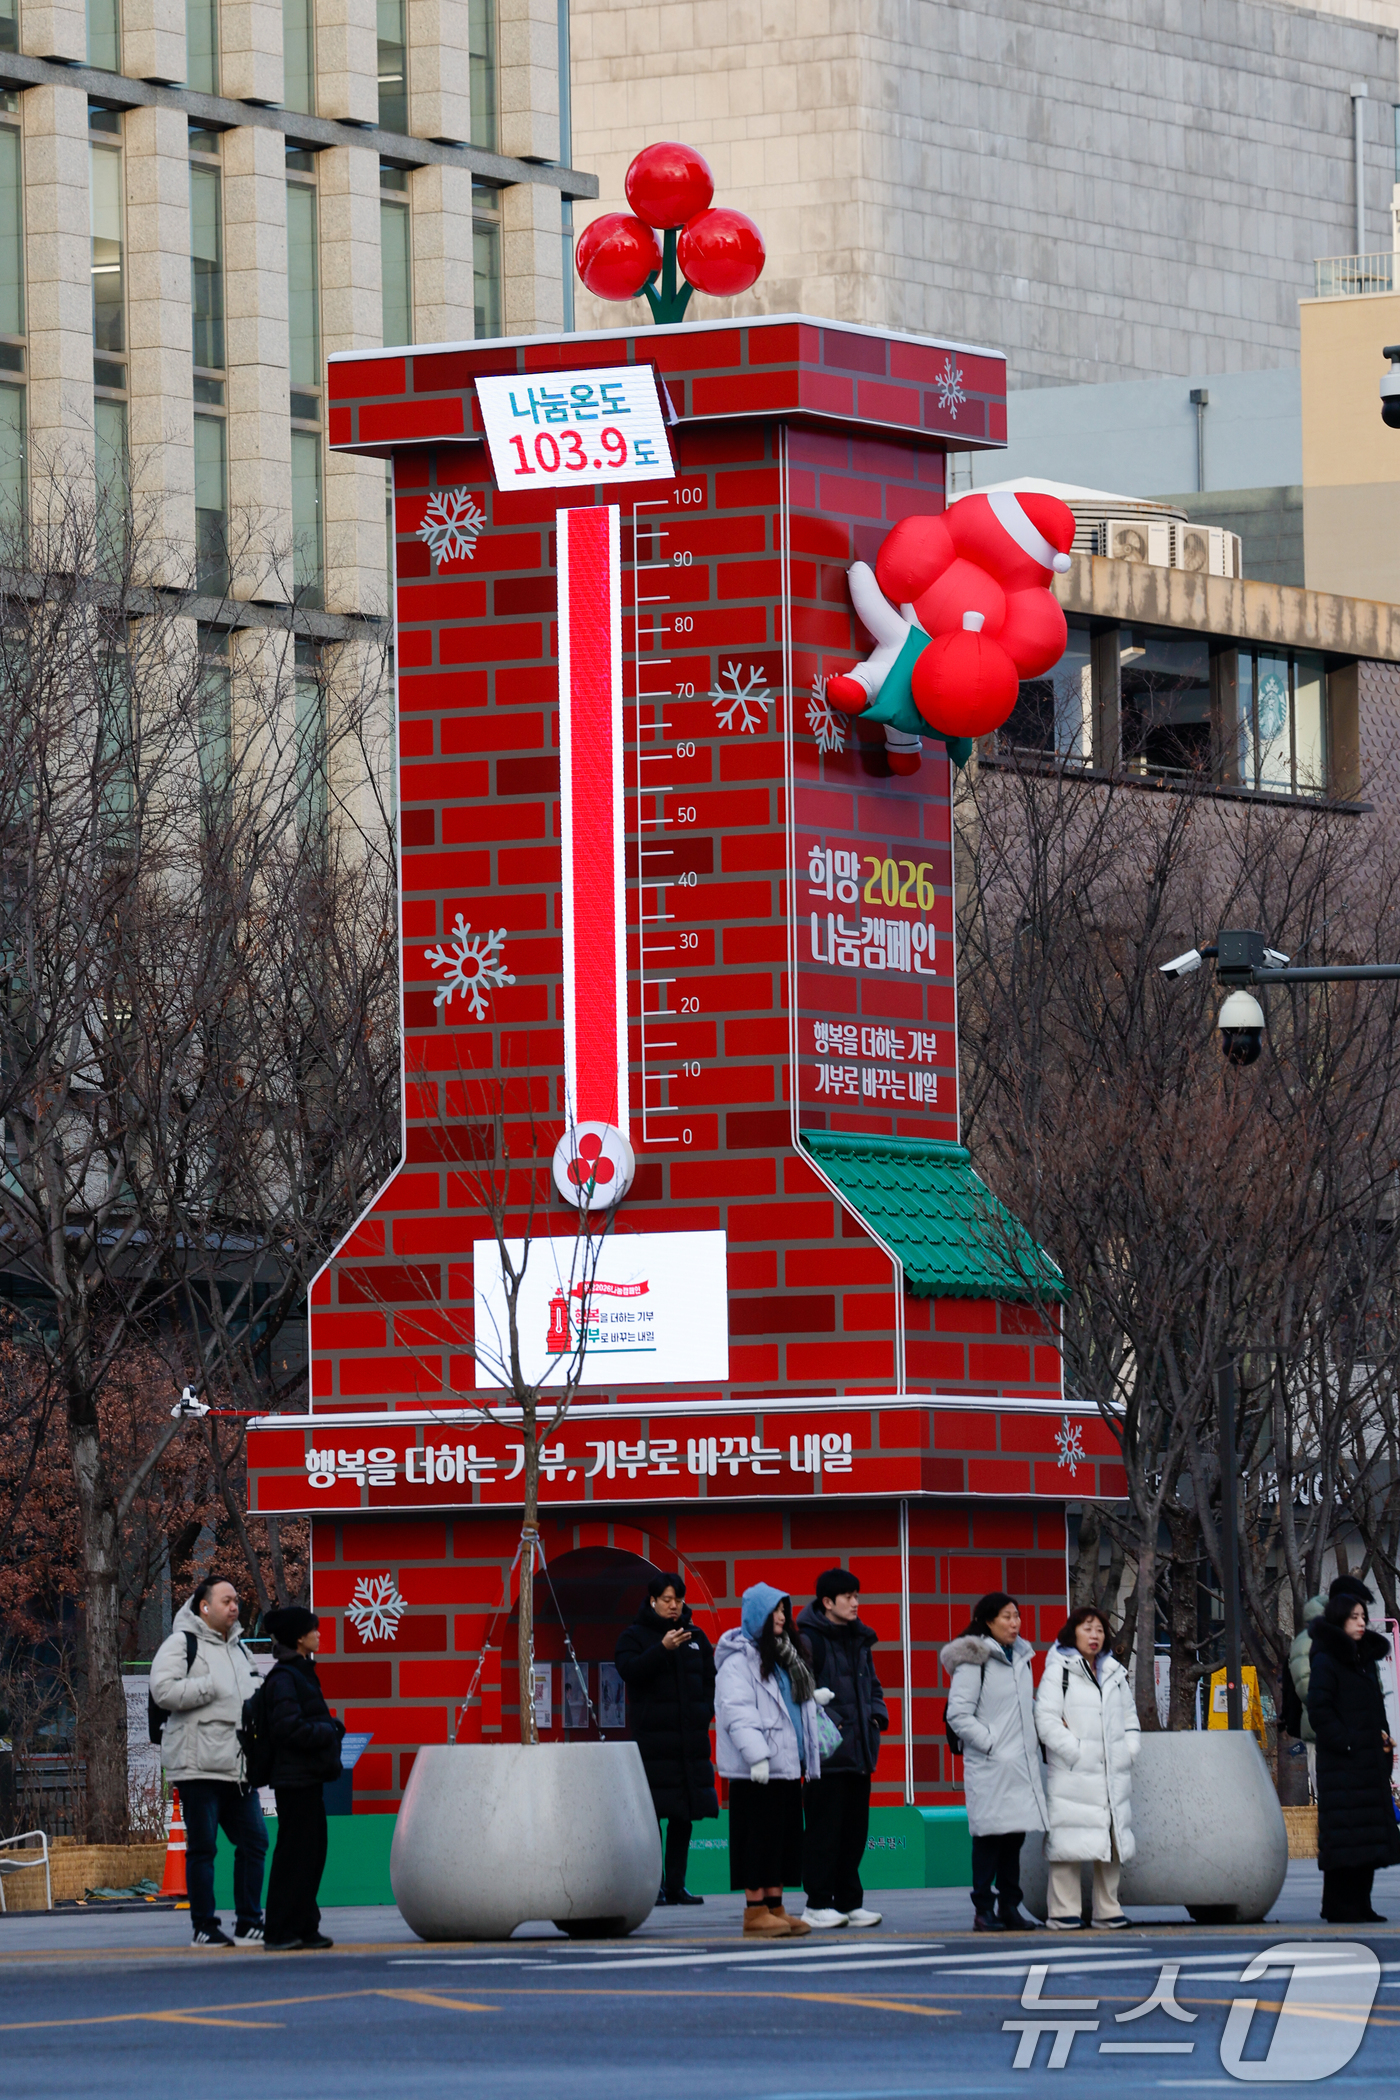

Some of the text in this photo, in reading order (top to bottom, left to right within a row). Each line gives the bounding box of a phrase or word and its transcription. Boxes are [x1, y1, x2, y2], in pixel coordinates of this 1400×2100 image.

[508, 383, 632, 425] 나눔온도
[673, 487, 702, 505] 100
[673, 551, 693, 567] 90
[674, 616, 694, 633] 80
[675, 682, 695, 699] 70
[676, 742, 696, 758] 60
[677, 806, 697, 823] 50
[677, 871, 698, 887] 40
[679, 933, 699, 949] 30
[810, 911, 937, 975] 나눔캠페인
[680, 997, 700, 1013] 20
[813, 1021, 938, 1063] 행복을 더하는 기부
[682, 1061, 701, 1078] 10
[814, 1063, 938, 1104] 기부로 바꾸는 내일
[682, 1128, 693, 1144] 0
[610, 1311, 635, 1323] 더하는
[637, 1311, 654, 1322] 기부
[610, 1332, 636, 1343] 바꾸는
[637, 1331, 655, 1342] 내일
[305, 1447, 398, 1489] 행복을
[405, 1443, 498, 1485] 더하는
[585, 1439, 680, 1479] 기부로
[687, 1435, 782, 1476] 바꾸는
[789, 1432, 853, 1475] 내일
[867, 1835, 906, 1850] 울특별시
